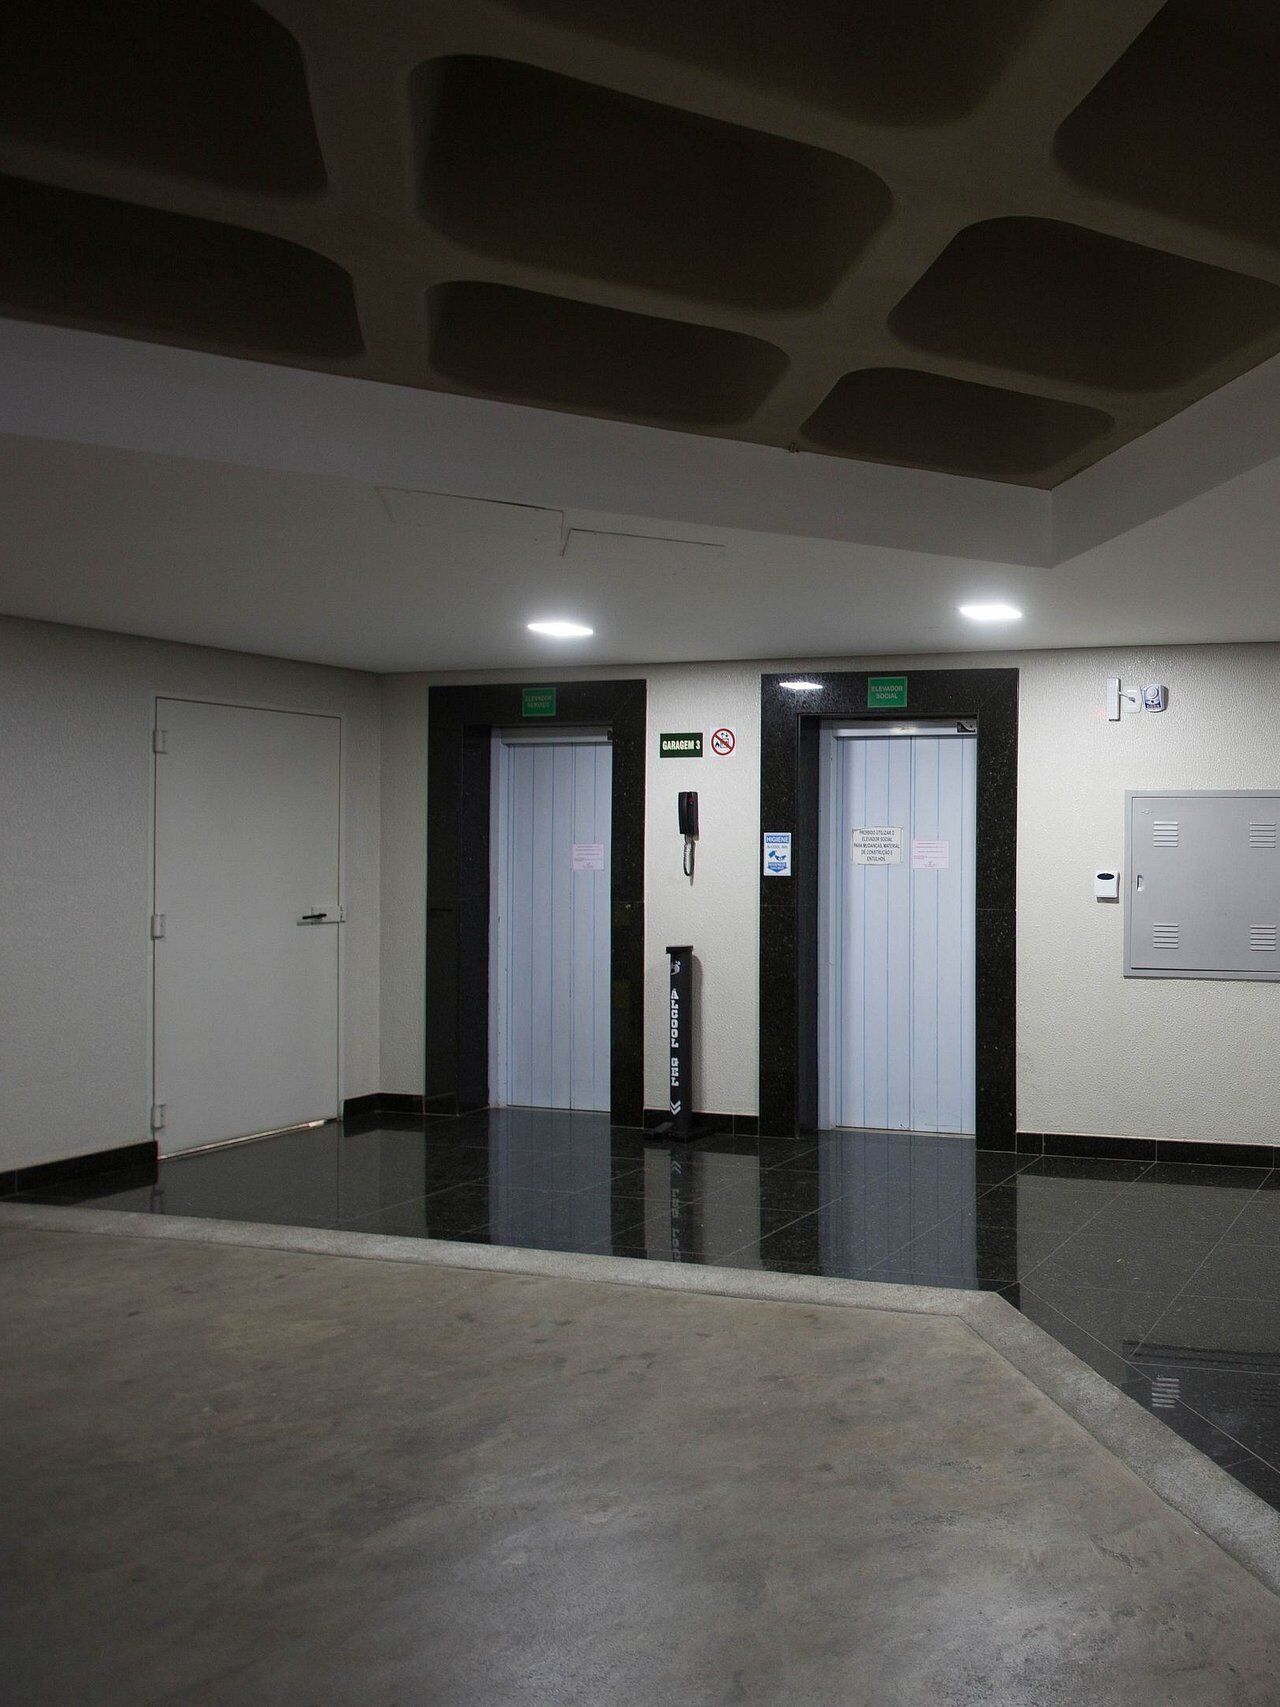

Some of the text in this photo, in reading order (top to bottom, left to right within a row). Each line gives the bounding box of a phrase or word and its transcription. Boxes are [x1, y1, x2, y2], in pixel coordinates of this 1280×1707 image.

[662, 740, 700, 750] GARAGEM 3
[671, 988, 680, 1048] ÁLCOOL
[671, 1057, 680, 1087] GEL
